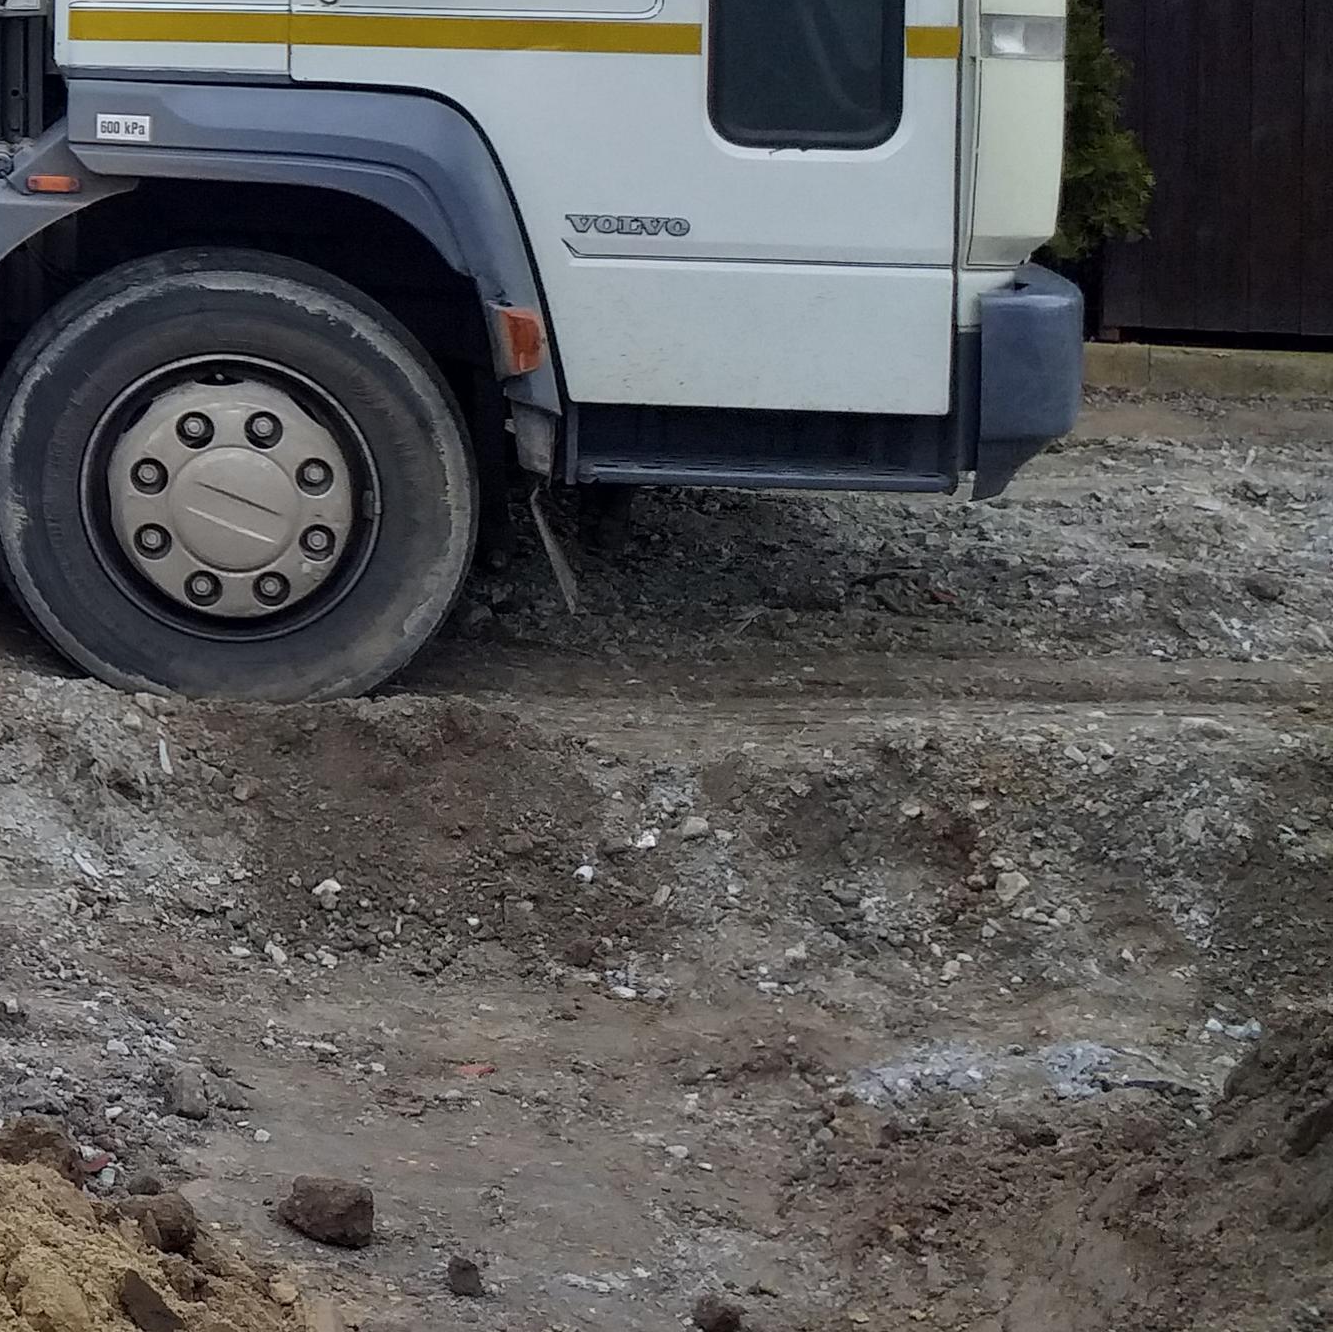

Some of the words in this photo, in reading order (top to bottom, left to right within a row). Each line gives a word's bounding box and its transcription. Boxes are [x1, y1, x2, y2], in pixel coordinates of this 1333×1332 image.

[100, 120, 120, 134] 600
[124, 121, 145, 136] kPa
[565, 214, 691, 237] VOLVO
